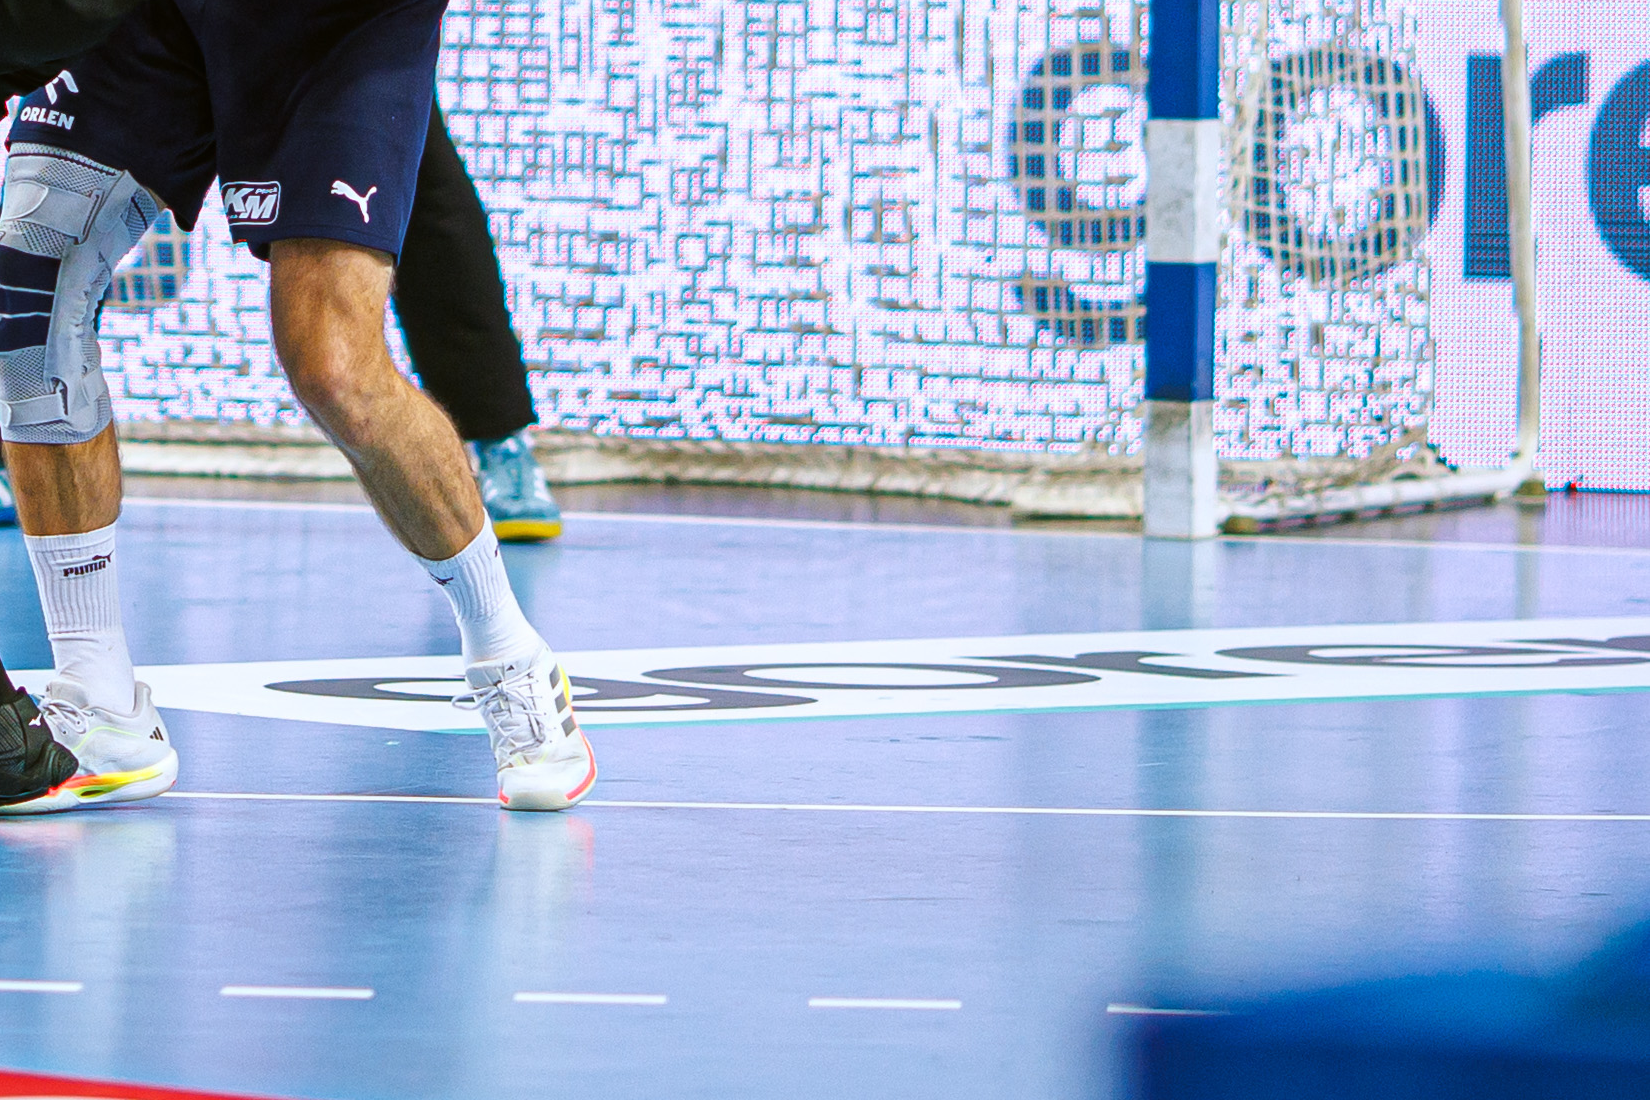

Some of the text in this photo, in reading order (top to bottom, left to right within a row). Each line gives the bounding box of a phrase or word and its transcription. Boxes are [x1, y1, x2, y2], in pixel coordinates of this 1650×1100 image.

[20, 106, 75, 130] ORLEN
[223, 187, 278, 220] KM
[63, 560, 107, 577] PUMA
